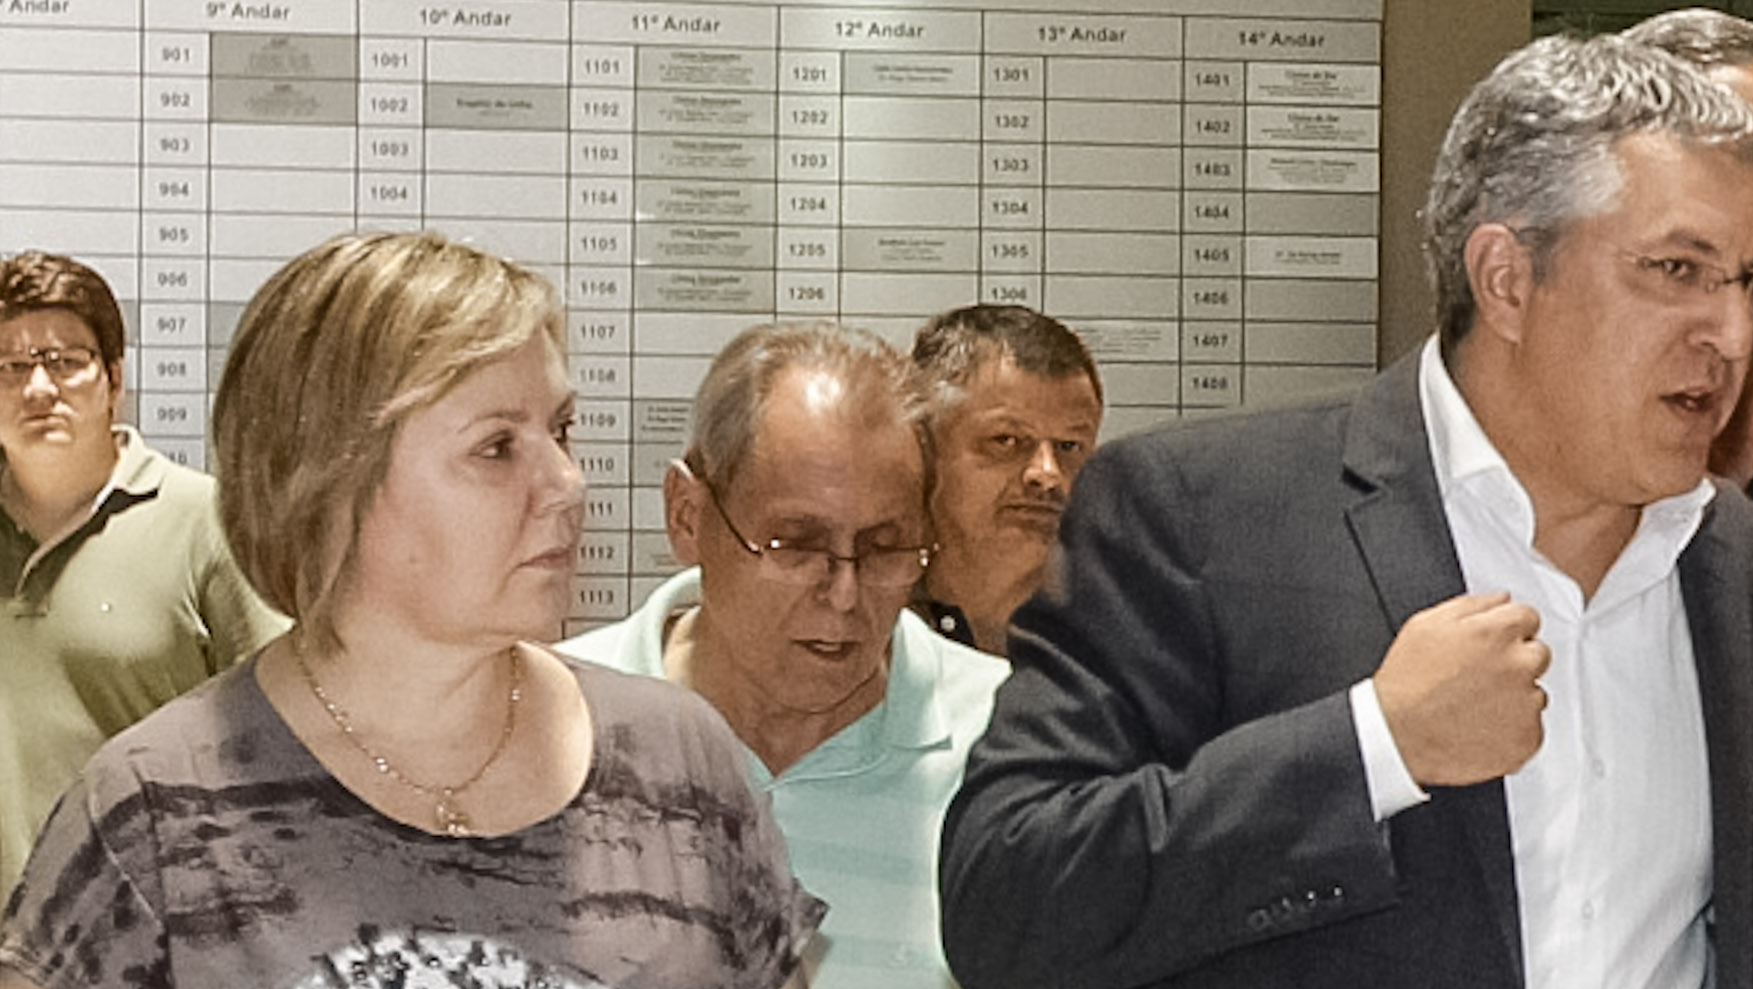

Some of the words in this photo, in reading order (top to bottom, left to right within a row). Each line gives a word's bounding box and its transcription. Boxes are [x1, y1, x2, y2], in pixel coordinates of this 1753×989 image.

[232, 3, 289, 19] Andar
[454, 10, 511, 25] Andar
[664, 16, 720, 32] Andar
[868, 23, 925, 38] Andar
[1071, 27, 1125, 42] Andar
[1270, 32, 1324, 47] Andar
[162, 48, 189, 61] 901
[372, 53, 407, 68] 1001
[586, 60, 619, 73] 1101
[793, 67, 826, 81] 1201
[994, 68, 1028, 81] 1301
[1196, 74, 1229, 86] 1401
[161, 93, 190, 107] 902
[372, 98, 408, 112] 1002
[584, 102, 619, 117] 1102
[793, 111, 827, 124] 1202
[995, 115, 1029, 129] 1302
[1197, 120, 1230, 133] 1402
[161, 138, 189, 152] 903
[372, 141, 408, 156] 1003
[583, 146, 618, 160] 1103
[792, 154, 827, 168] 1203
[993, 159, 1029, 172] 1303
[1195, 163, 1230, 176] 1403
[160, 183, 188, 196] 904
[371, 187, 407, 200] 1004
[583, 190, 617, 204] 1104
[791, 198, 826, 210] 1204
[993, 202, 1028, 214] 1304
[1196, 206, 1229, 219] 1404
[160, 228, 188, 242] 905
[581, 237, 616, 251] 1105
[790, 244, 825, 256] 1205
[993, 244, 1029, 258] 1305
[1195, 249, 1229, 261] 1405
[158, 272, 187, 286] 906
[582, 281, 616, 294] 1106
[789, 287, 824, 300] 1206
[992, 288, 1027, 301] 1306
[1194, 292, 1228, 304] 1406
[158, 318, 186, 332] 907
[581, 325, 615, 339] 1107
[1194, 334, 1228, 347] 1407
[158, 363, 186, 376] 908
[581, 369, 615, 382] 1108
[158, 408, 187, 421] 909
[581, 413, 616, 427] 1109
[580, 458, 614, 471] 1110
[580, 546, 614, 559] 1112
[580, 590, 613, 603] 1113
